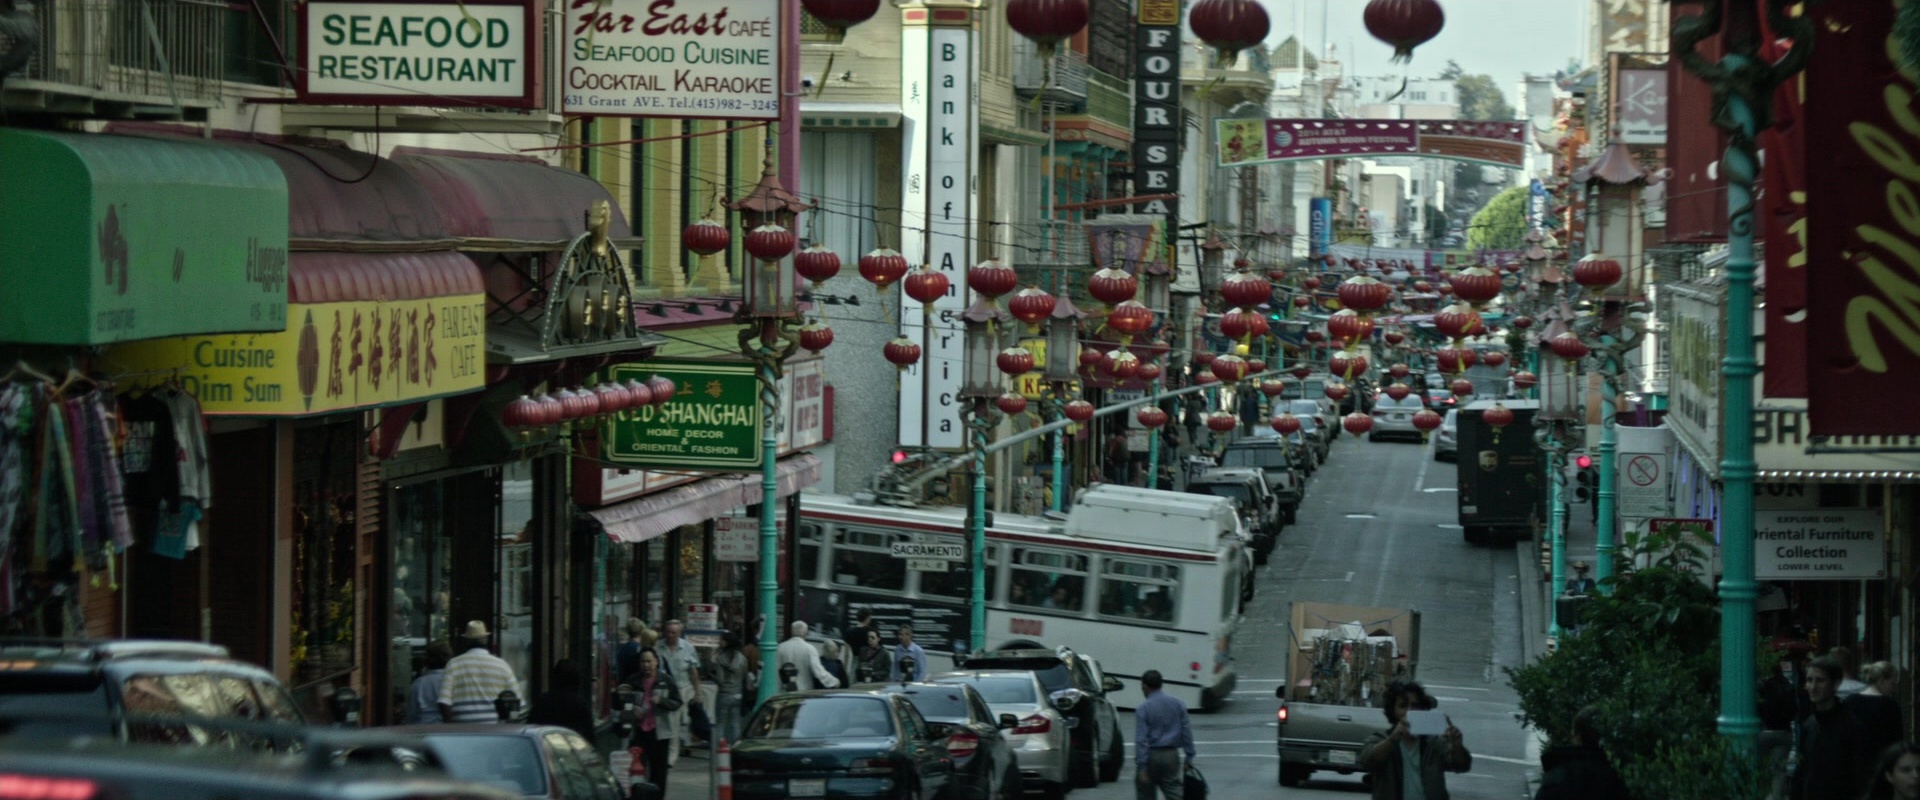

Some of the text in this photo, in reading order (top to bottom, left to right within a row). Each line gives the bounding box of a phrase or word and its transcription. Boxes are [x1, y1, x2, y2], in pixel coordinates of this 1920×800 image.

[322, 14, 509, 48] SEAFOOD
[570, 0, 771, 37] Far East CAFÉ
[573, 38, 770, 65] SEAFOOD CUISINE
[318, 55, 516, 83] RESTAURANT
[569, 67, 772, 94] COCKTAIL KARAOKE
[1145, 30, 1171, 125] FOUR
[564, 95, 583, 106] 631
[588, 96, 627, 107] Grant
[633, 97, 664, 107] AVE.
[942, 43, 956, 146] Bank
[1298, 136, 1410, 145] AUTUMN MOON FESTIVAL
[1143, 145, 1169, 214] SEA
[942, 176, 953, 220] of
[442, 306, 460, 338] FAR
[194, 339, 275, 368] Cuisine
[180, 375, 281, 402] Dim Sum
[1113, 393, 1140, 401] SALE
[658, 401, 755, 427] SHANGHAI
[646, 428, 724, 439] HOME DECOR
[680, 437, 689, 446] &
[632, 443, 738, 455] ORIENTAL FASHION
[1777, 516, 1845, 524] EXPLORE OUR
[1809, 528, 1875, 541] Furniture
[893, 544, 962, 557] SACRAMENTO
[1776, 546, 1847, 559] Collection
[1778, 563, 1844, 571] LOWER LEVEL
